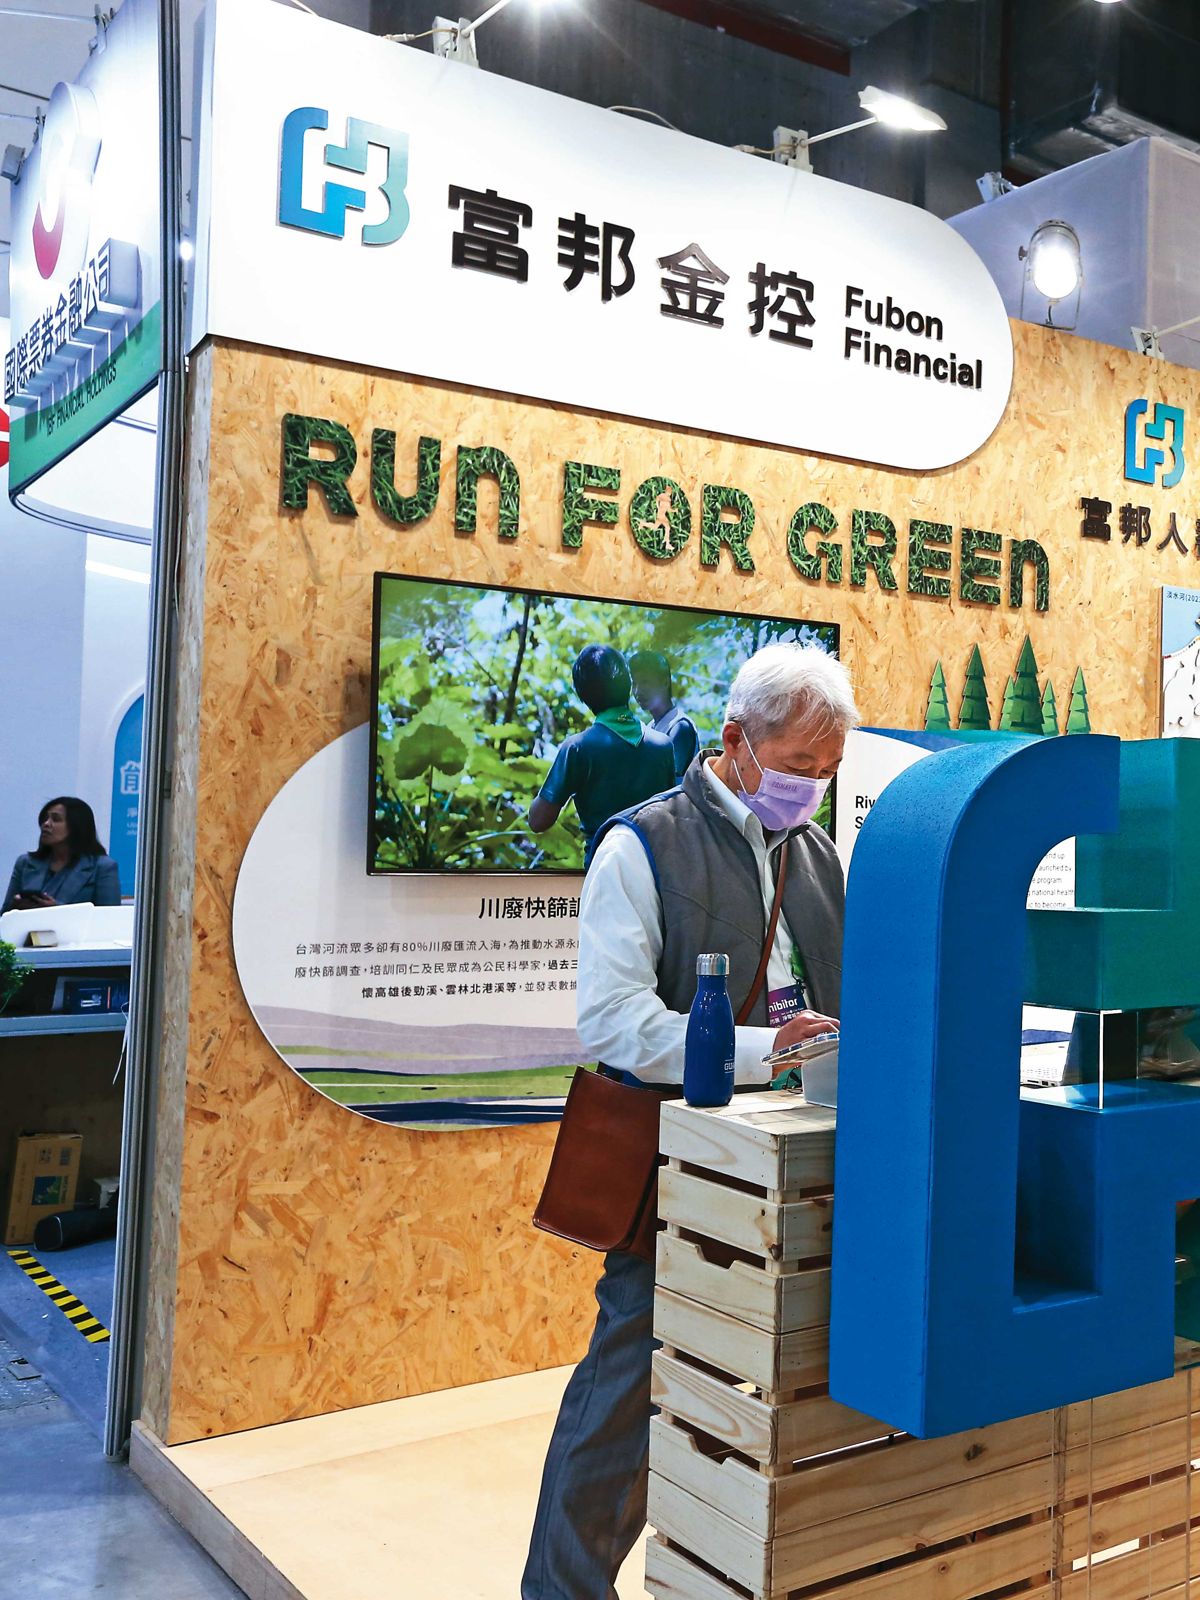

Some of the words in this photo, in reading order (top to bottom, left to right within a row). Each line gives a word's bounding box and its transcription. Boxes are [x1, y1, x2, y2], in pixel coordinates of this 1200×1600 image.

[448, 184, 816, 348] 富邦金控
[845, 285, 944, 341] Fubon
[844, 327, 983, 389] Financial
[56, 391, 85, 427] FINANCIAL
[86, 360, 117, 403] HOLDINGS
[561, 459, 755, 572] FOR
[786, 502, 1050, 612] GREEN
[855, 795, 876, 809] Riv
[1039, 864, 1064, 872] aunched
[296, 939, 580, 955] 台灣河流眾多卻有80%川廢匯流入海，為推動水源永
